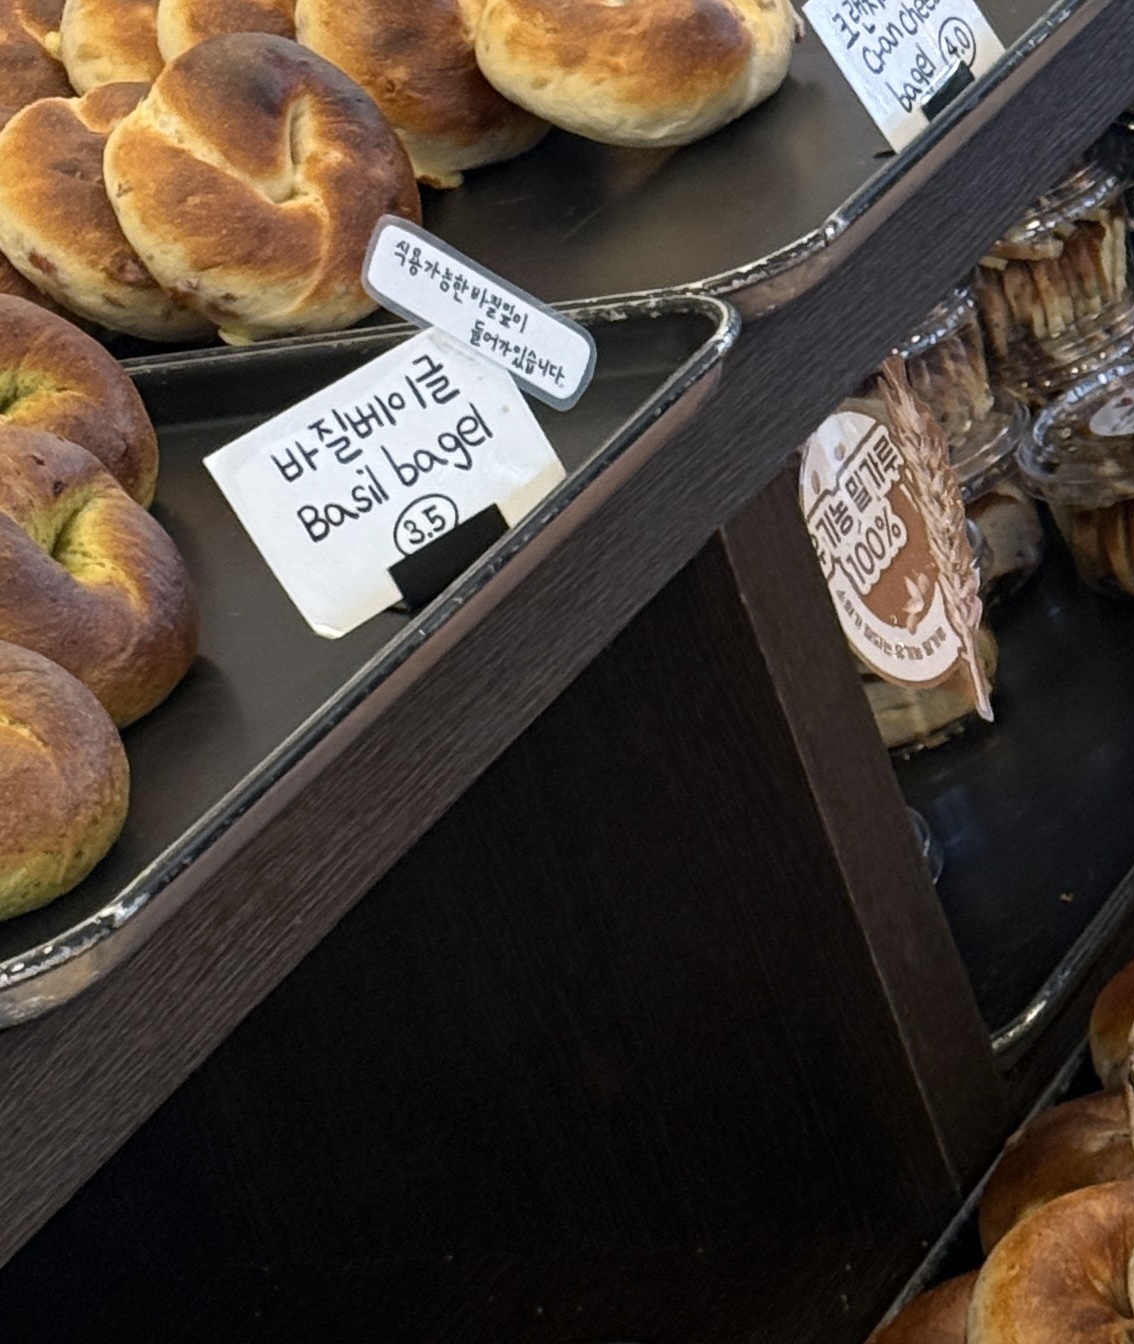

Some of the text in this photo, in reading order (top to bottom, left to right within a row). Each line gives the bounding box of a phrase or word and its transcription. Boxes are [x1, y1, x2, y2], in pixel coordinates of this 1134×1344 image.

[885, 26, 971, 114] bagel 4.0
[270, 354, 460, 483] 바질베이글
[296, 402, 494, 543] Basil bagel
[845, 434, 898, 513] 밀가루
[402, 505, 448, 545] 3.5
[845, 507, 902, 584] 100%
